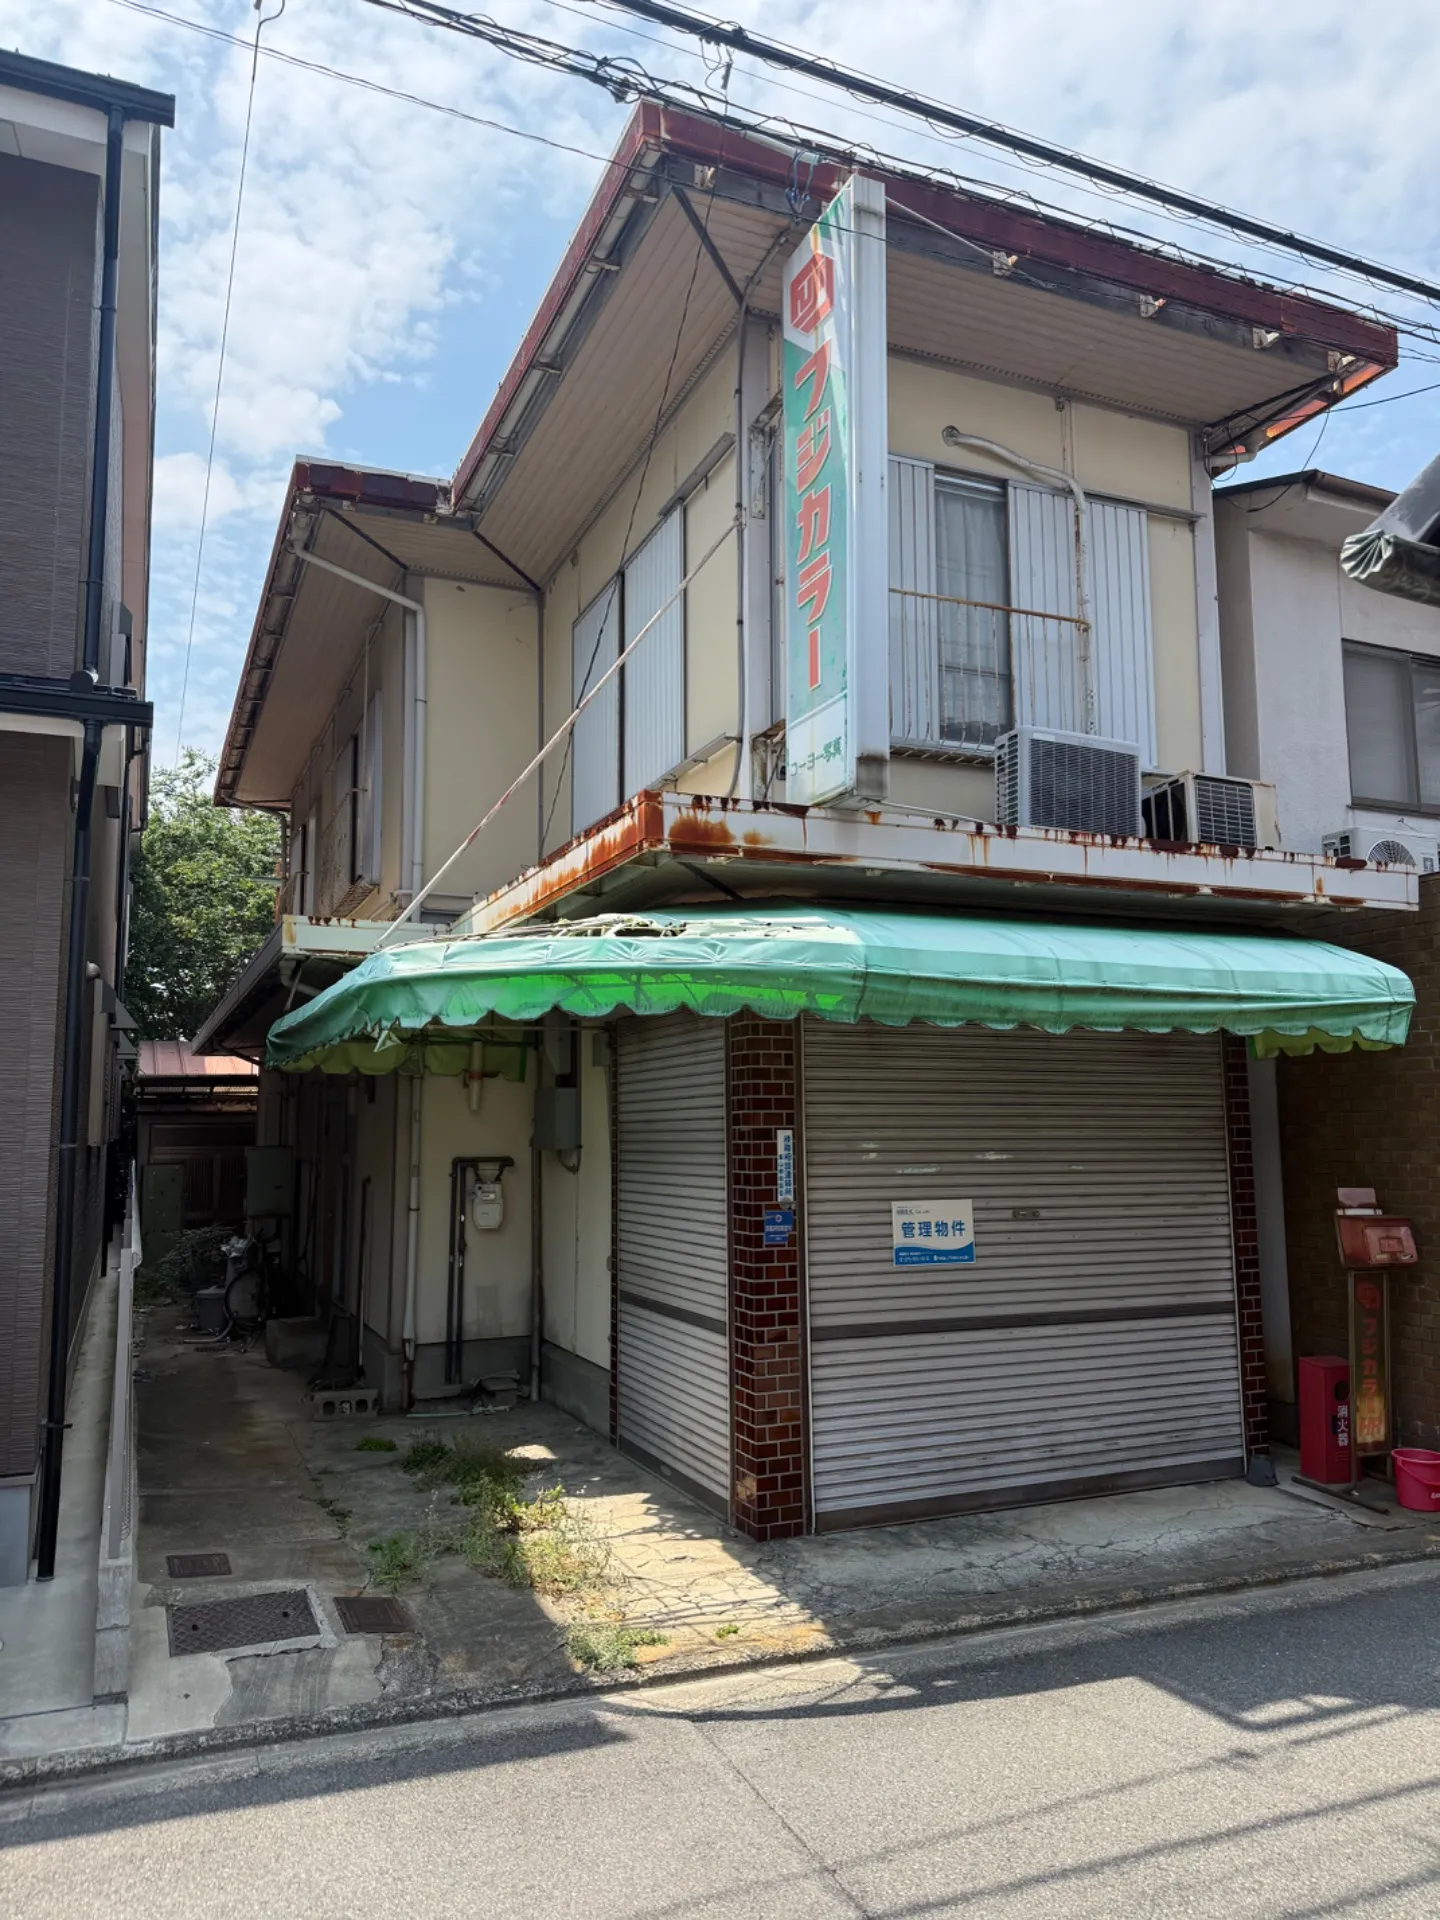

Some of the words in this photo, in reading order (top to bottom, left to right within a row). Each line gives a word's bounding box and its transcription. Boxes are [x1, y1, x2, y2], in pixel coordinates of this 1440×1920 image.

[794, 339, 833, 692] フジカラー
[790, 736, 842, 777] コーヨー写真
[901, 1219, 966, 1239] 管理物件
[1360, 1317, 1378, 1414] フジカラー
[1337, 1405, 1350, 1447] 消火器
